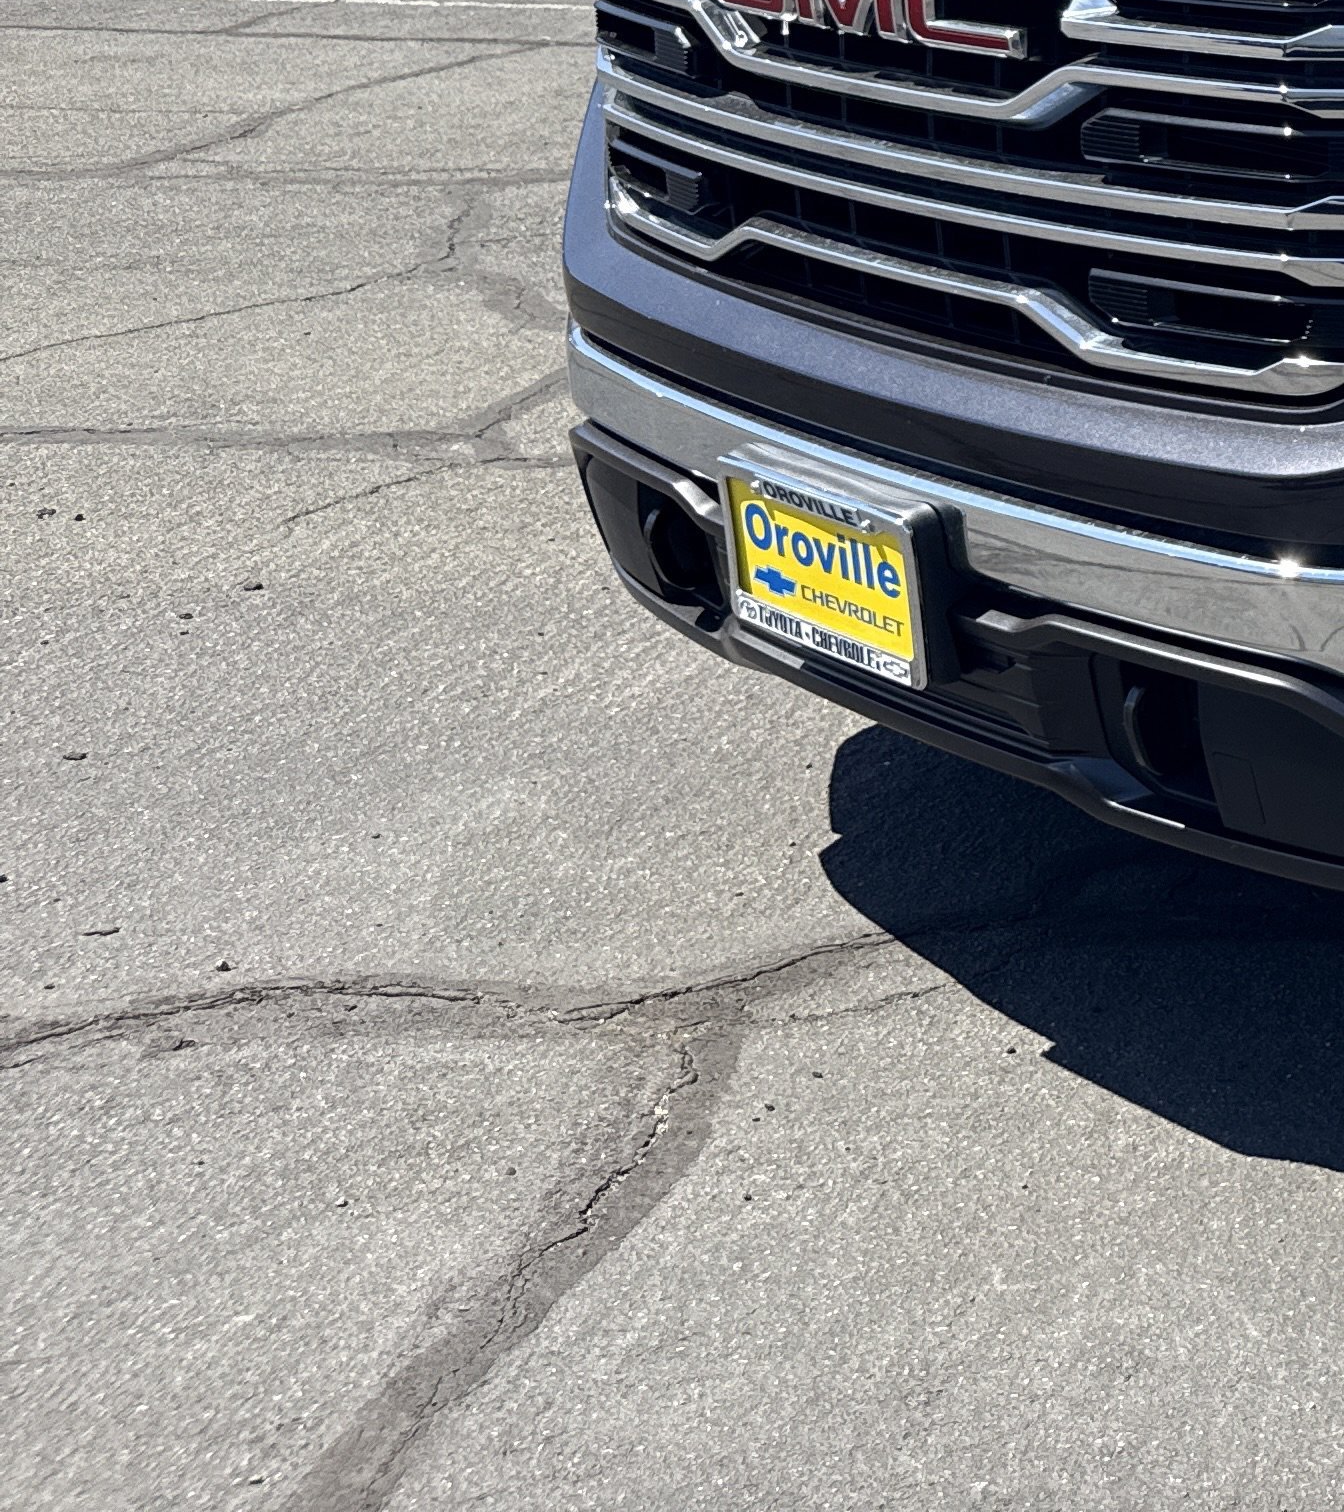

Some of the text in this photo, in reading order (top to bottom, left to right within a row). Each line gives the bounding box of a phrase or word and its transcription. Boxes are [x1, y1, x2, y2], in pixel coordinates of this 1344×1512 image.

[763, 481, 858, 527] OROVILLE
[745, 503, 901, 598] Oroville
[801, 586, 904, 636] CHEVROLET
